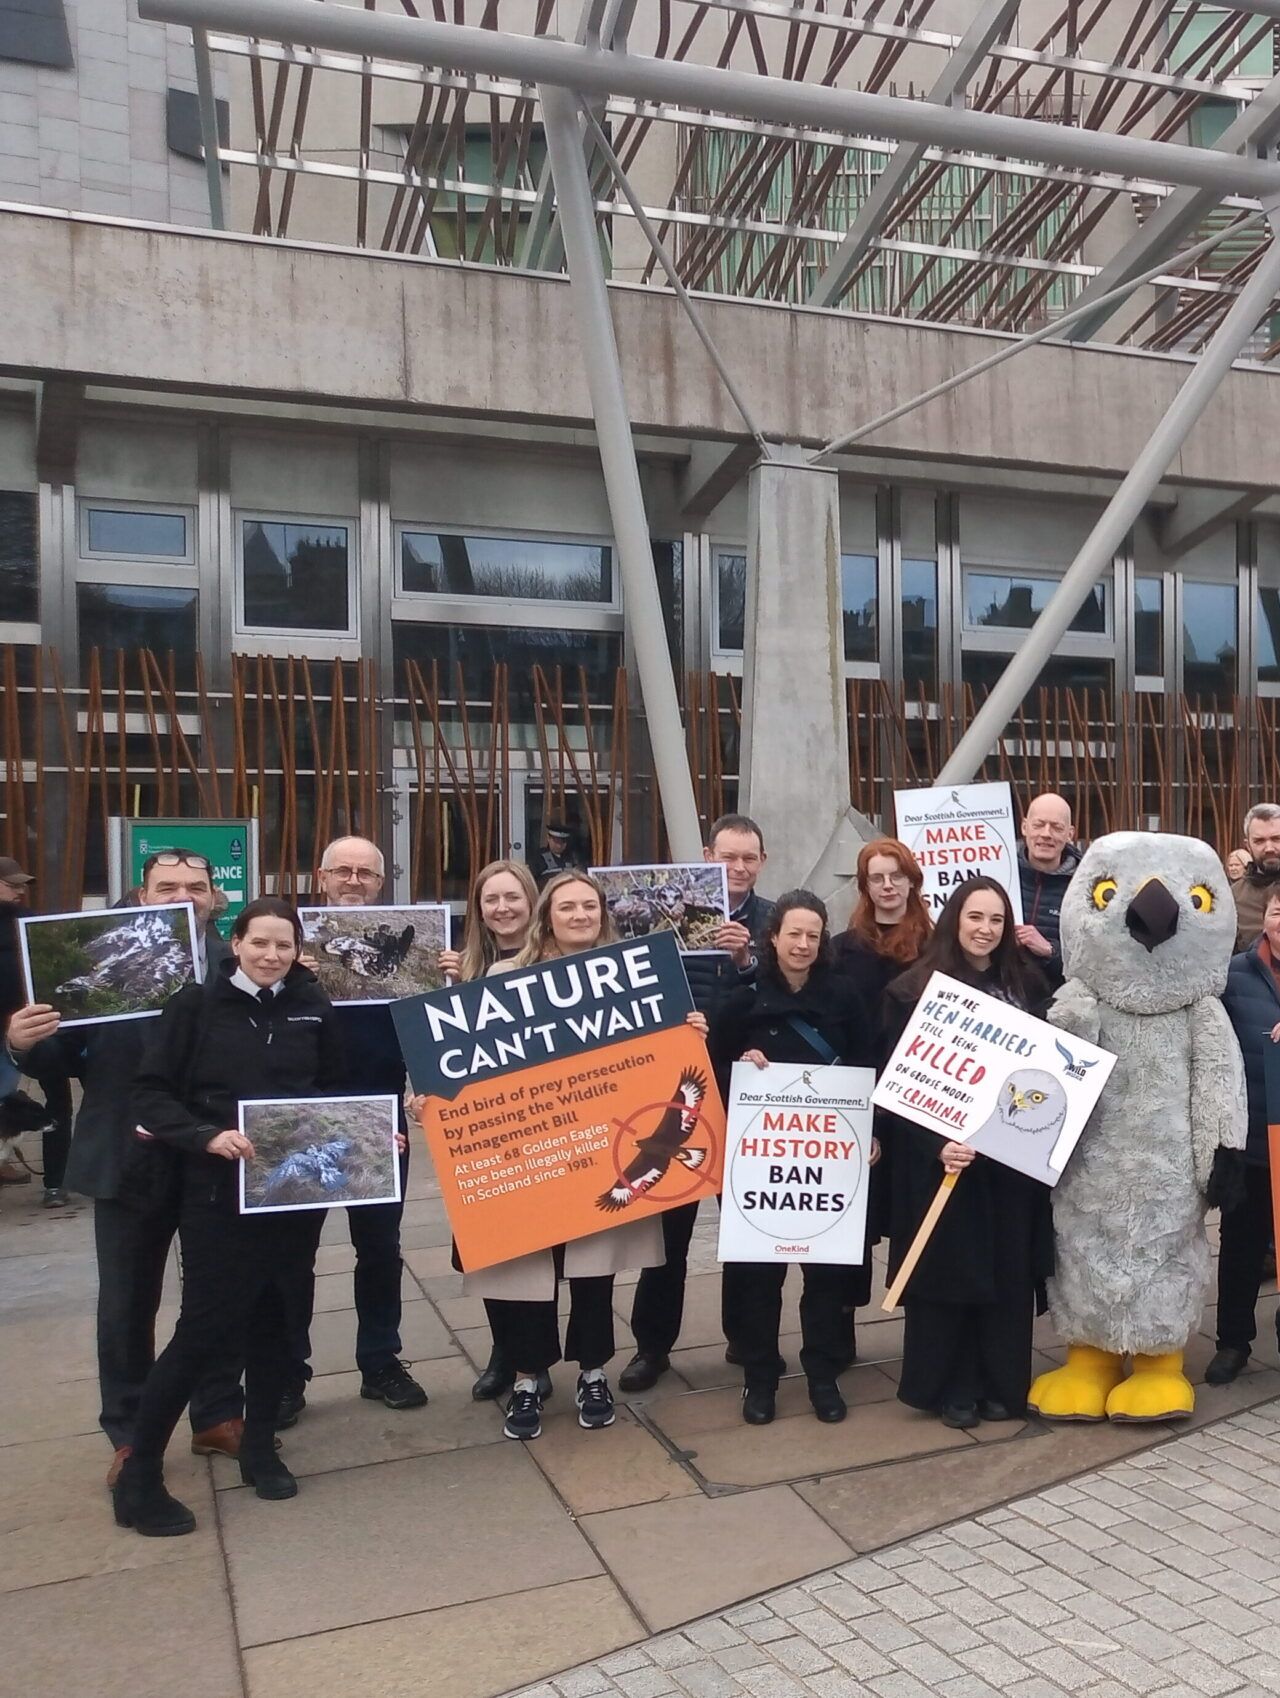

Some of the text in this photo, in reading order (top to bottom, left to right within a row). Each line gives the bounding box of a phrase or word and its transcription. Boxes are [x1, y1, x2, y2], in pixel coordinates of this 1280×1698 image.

[904, 815, 922, 823] Dear
[924, 812, 955, 821] Scottish
[926, 825, 986, 844] MAKE
[912, 845, 1003, 866] HISTORY
[424, 945, 660, 1042] NATURE
[937, 990, 980, 1013] WHY ARE
[439, 993, 664, 1079] CAN'T WAIT
[919, 1021, 977, 1053] STILL BEING
[923, 1000, 1037, 1058] HEN HARRIERS
[895, 1063, 909, 1075] ON
[910, 1069, 942, 1090] GROUSE
[905, 1035, 987, 1086] KILLED
[438, 1052, 656, 1122] End bird of prey persecution
[739, 1092, 865, 1107] Dear Scottish Government,
[443, 1081, 618, 1143] by passing the Wildlife
[885, 1080, 968, 1128] IT'S CRIMINAL
[449, 1110, 579, 1158] Management Bill
[762, 1112, 837, 1133] MAKE
[454, 1122, 609, 1176] At least 68 Golden Eagles
[458, 1136, 610, 1191] have been illegally killed
[740, 1138, 855, 1160] HISTORY
[461, 1157, 598, 1205] in Scotland since 1981.
[769, 1165, 823, 1185] BAN
[743, 1191, 845, 1212] SNARES
[774, 1244, 810, 1253] OneKind
